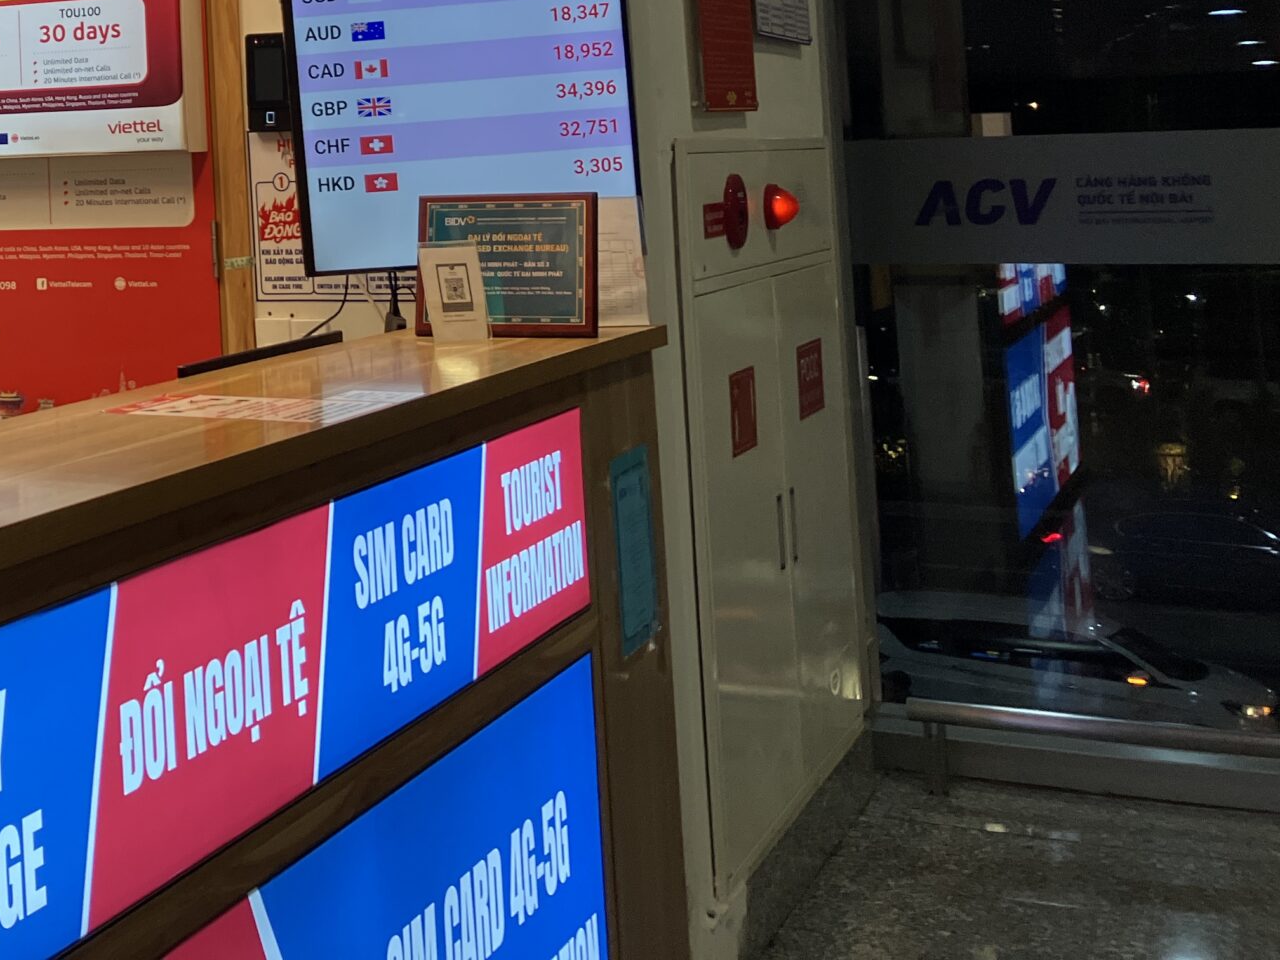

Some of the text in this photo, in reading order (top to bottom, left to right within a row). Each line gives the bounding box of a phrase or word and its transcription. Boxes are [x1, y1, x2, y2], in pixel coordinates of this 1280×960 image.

[59, 6, 101, 19] TOU100
[304, 3, 610, 42] AUD 18,347
[39, 21, 121, 45] 30 days
[43, 56, 89, 66] Unlimited Data
[43, 77, 51, 85] 20
[53, 76, 77, 84] Minutes
[120, 72, 132, 81] Call
[307, 41, 614, 80] CAD 18,952
[311, 80, 617, 117] GBP 34,396
[107, 119, 163, 135] viettel
[314, 138, 351, 155] CHF
[559, 118, 619, 139] 32,751
[278, 176, 283, 188] 1
[318, 157, 623, 193] HKD 3,305
[86, 198, 113, 206] Minutes
[161, 196, 175, 204] Call
[914, 177, 1057, 226] ACV
[445, 217, 467, 226] BIDV
[501, 450, 562, 535] TOURIST
[353, 498, 454, 609] SIM CARD
[485, 520, 584, 633] INFORMATION
[383, 595, 446, 693] 4G-5G
[120, 599, 309, 796] ĐỔI NGOẠI TỆ
[444, 848, 505, 960] CARD
[509, 790, 571, 926] 4G-5G
